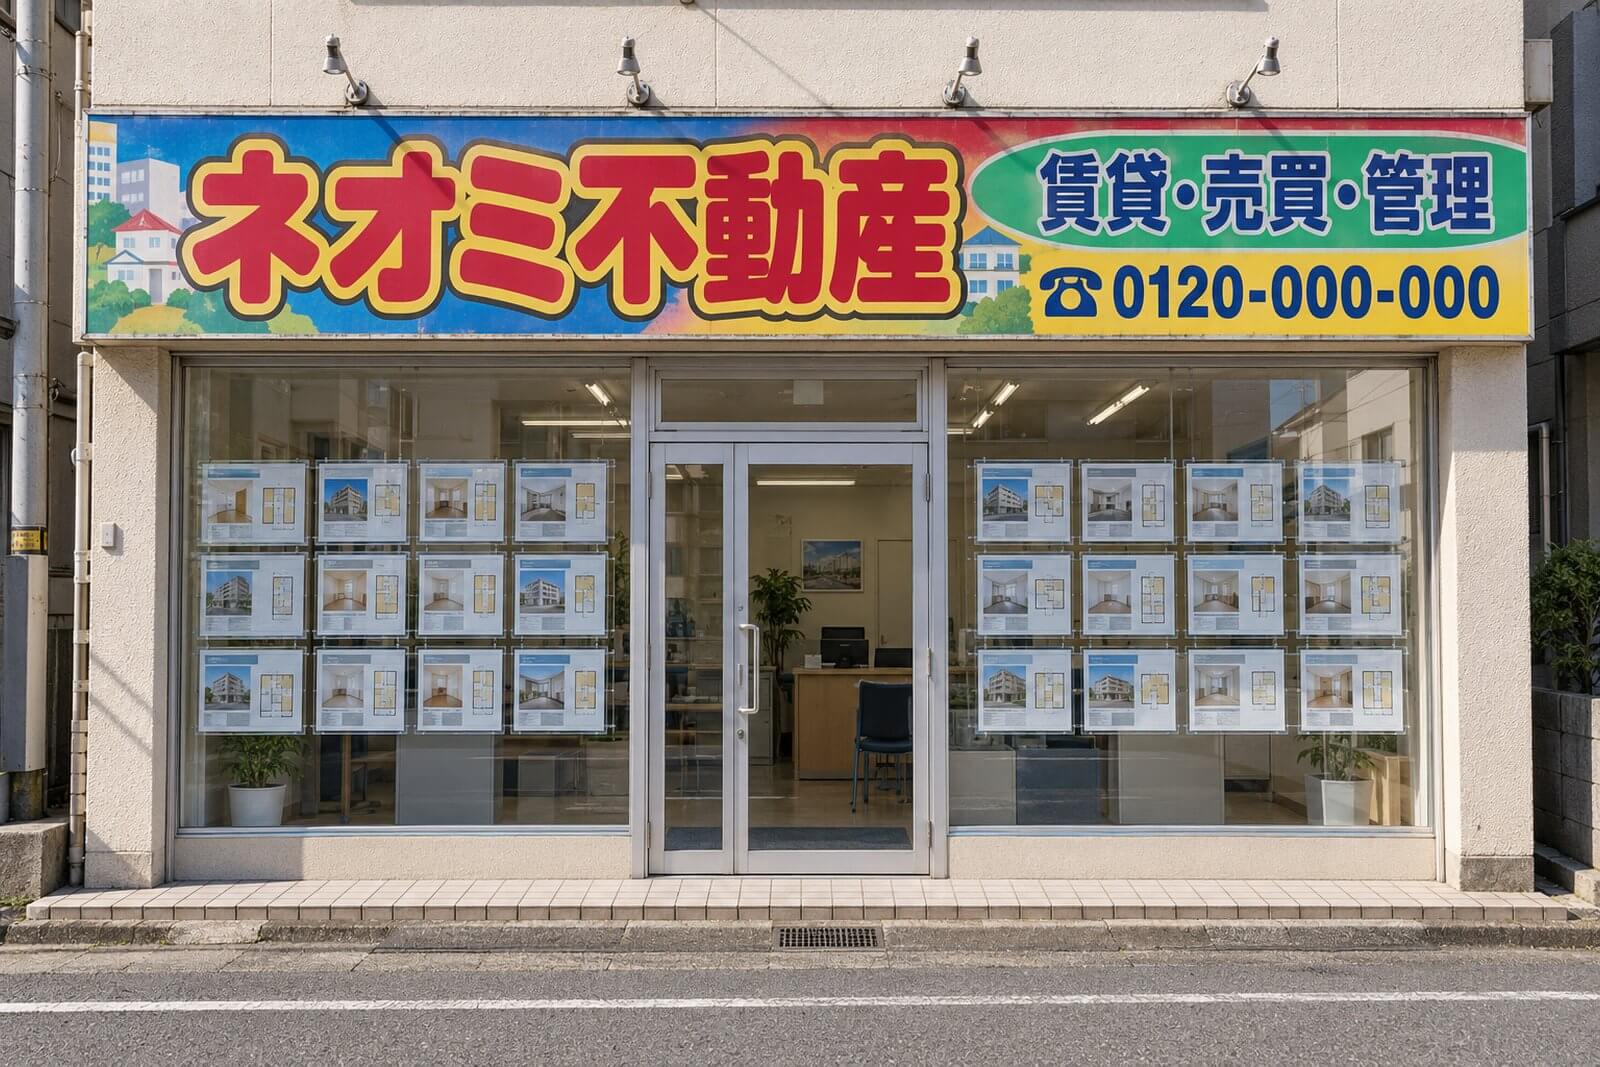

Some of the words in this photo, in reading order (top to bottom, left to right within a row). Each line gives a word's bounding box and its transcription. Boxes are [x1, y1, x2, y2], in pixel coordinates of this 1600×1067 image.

[190, 147, 953, 307] ネオミ不動産
[1038, 150, 1493, 234] 賃貸・売買・管理
[1114, 264, 1500, 319] 0120-000-000
